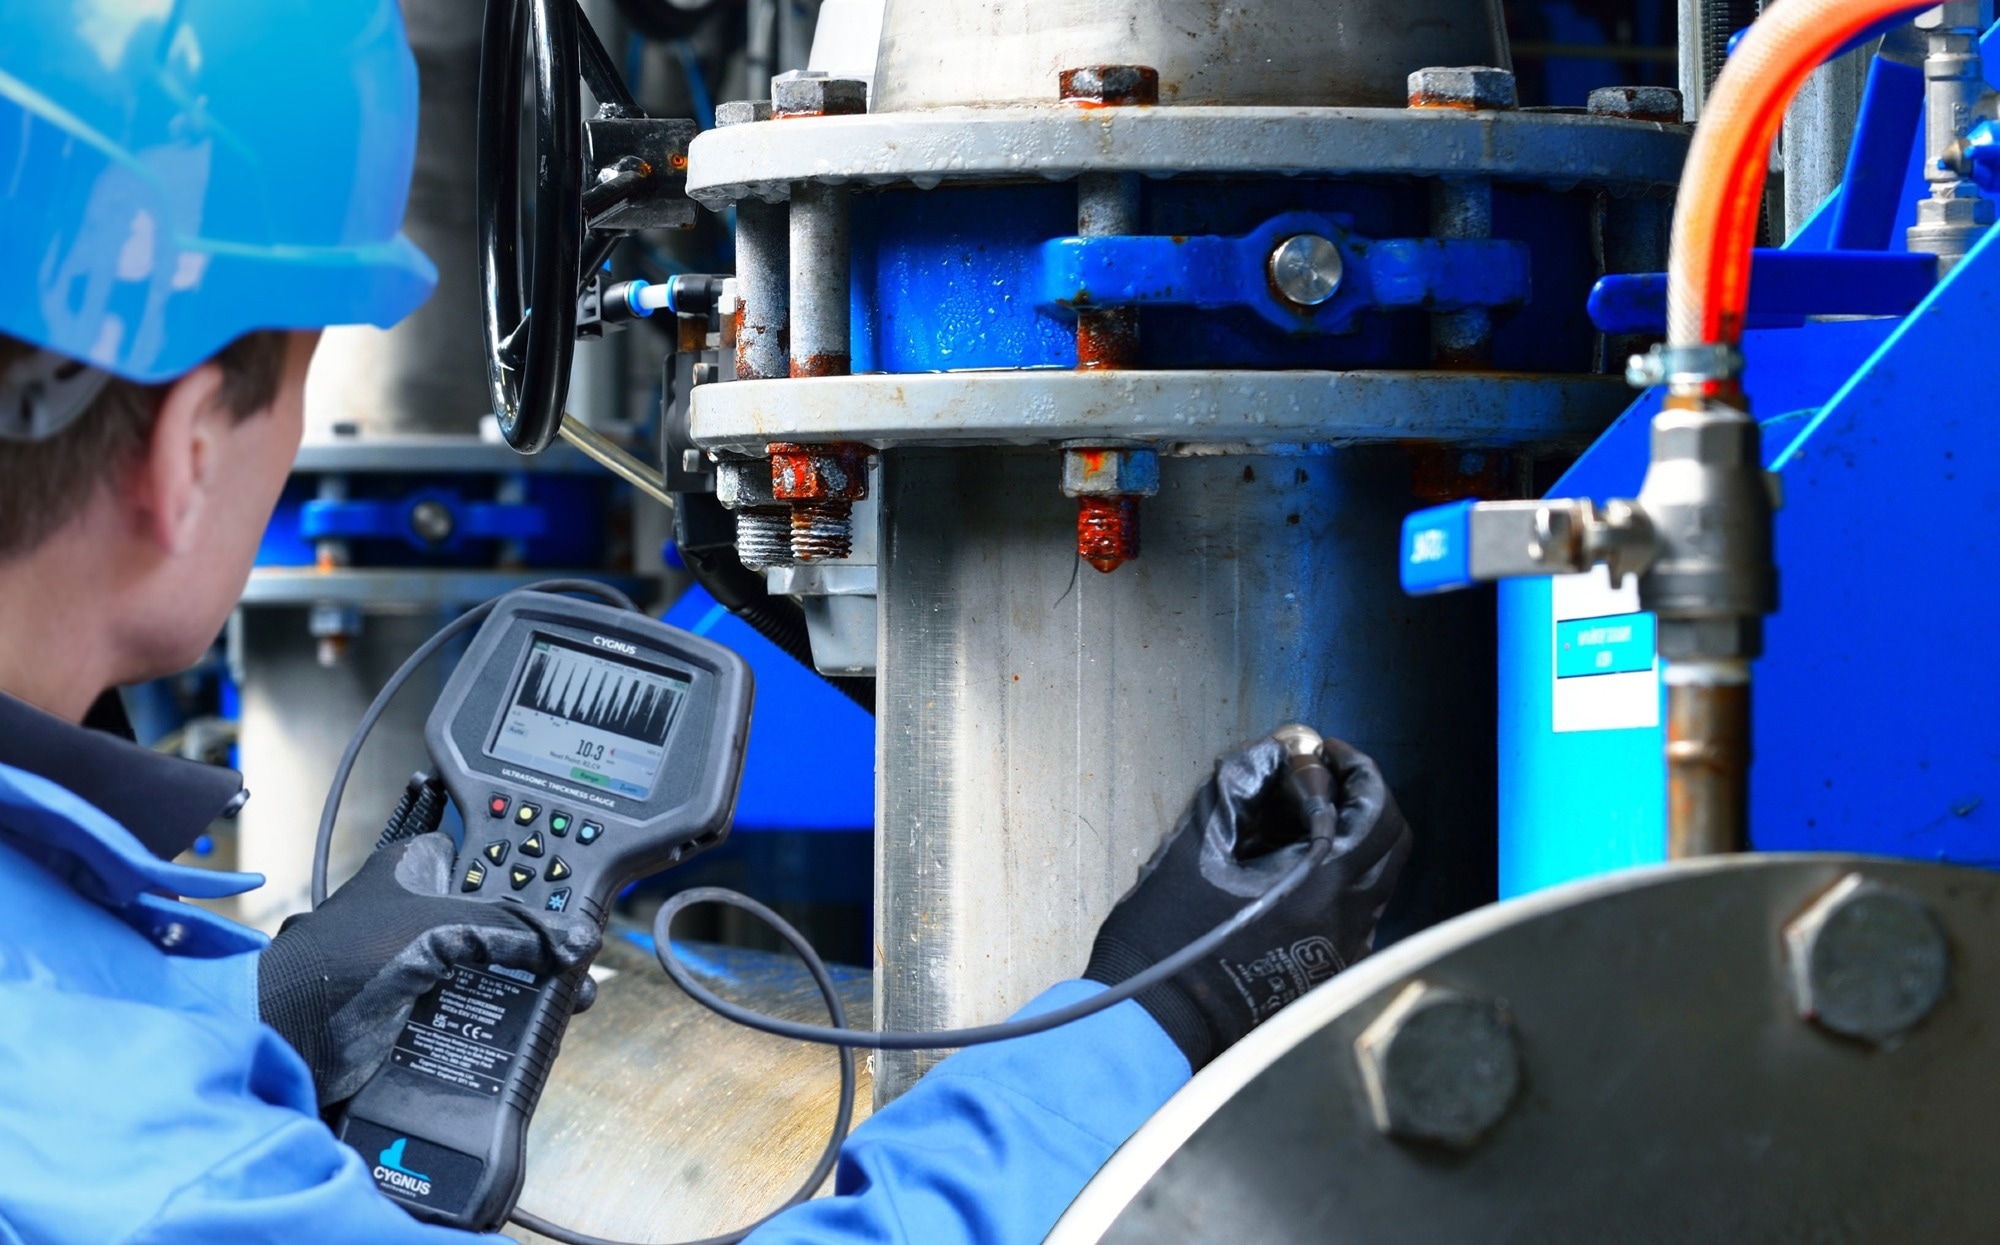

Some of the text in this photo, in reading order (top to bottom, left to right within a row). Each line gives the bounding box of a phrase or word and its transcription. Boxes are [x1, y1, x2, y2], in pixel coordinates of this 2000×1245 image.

[592, 635, 636, 655] CYGNUS
[575, 738, 605, 761] 10.3
[579, 771, 599, 783] Range
[501, 768, 615, 807] ULTRASONIC THICKNESS GAUGE
[460, 1022, 482, 1039] CE
[372, 1164, 432, 1196] CYGNUS
[379, 1180, 416, 1197] INSTRUMENTS
